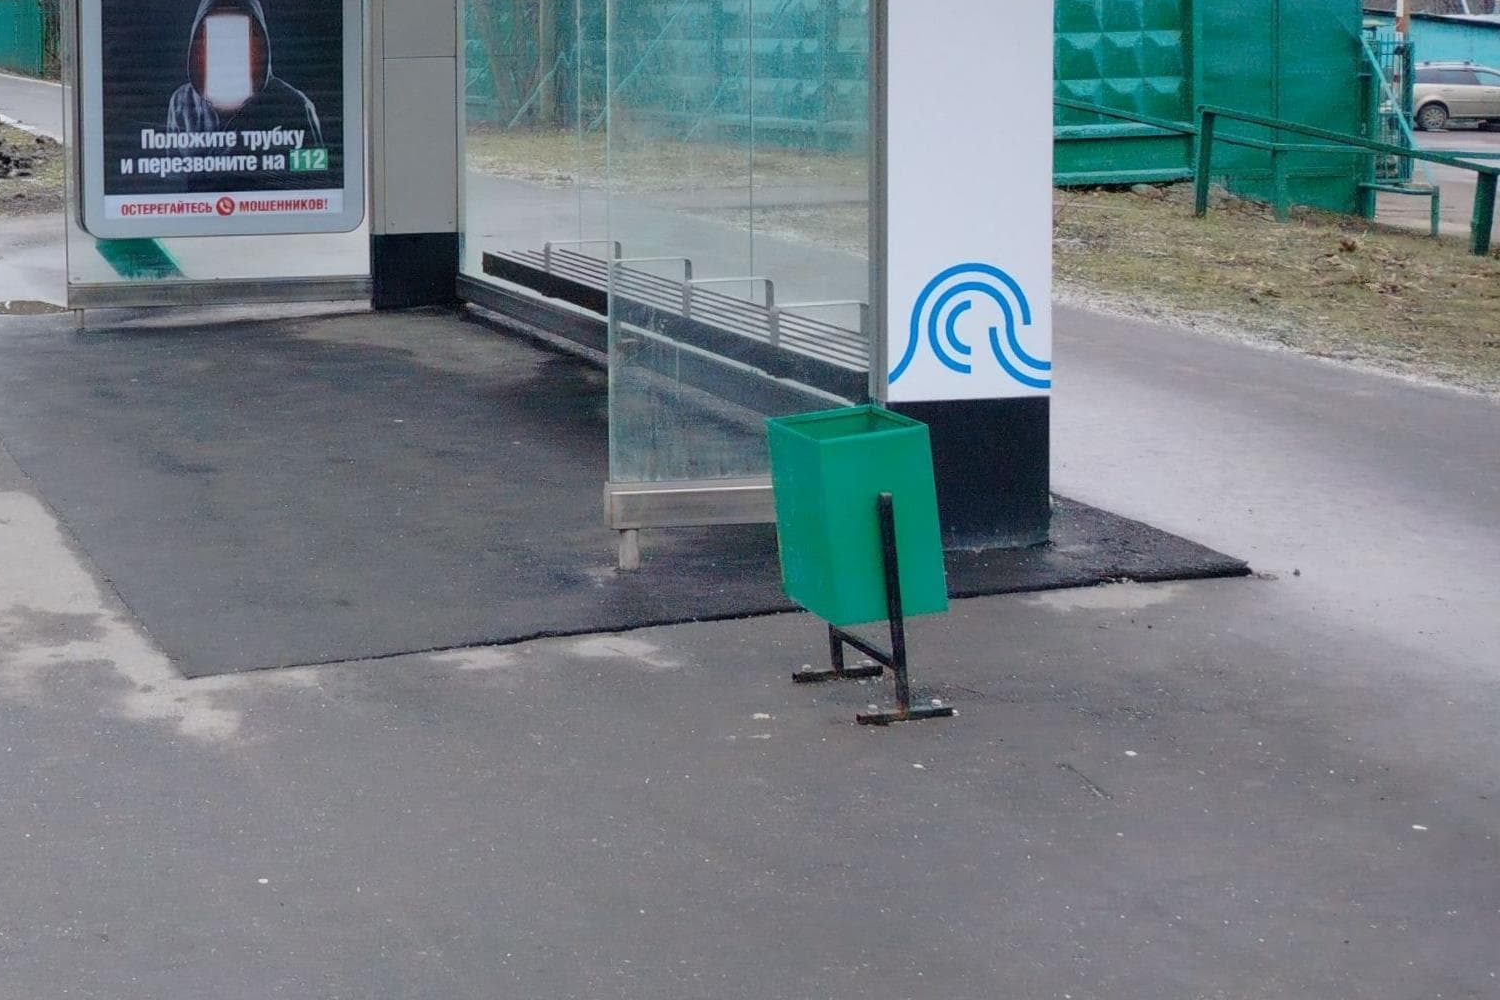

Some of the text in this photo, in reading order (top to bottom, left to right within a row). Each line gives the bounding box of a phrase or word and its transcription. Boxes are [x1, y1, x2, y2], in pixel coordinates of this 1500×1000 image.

[141, 126, 305, 150] Положите трубку
[120, 150, 326, 177] и перезвоните на 112
[121, 198, 328, 216] ОСТЕРЕГАЙТЕСЬ МОШЕННИКОВ!
